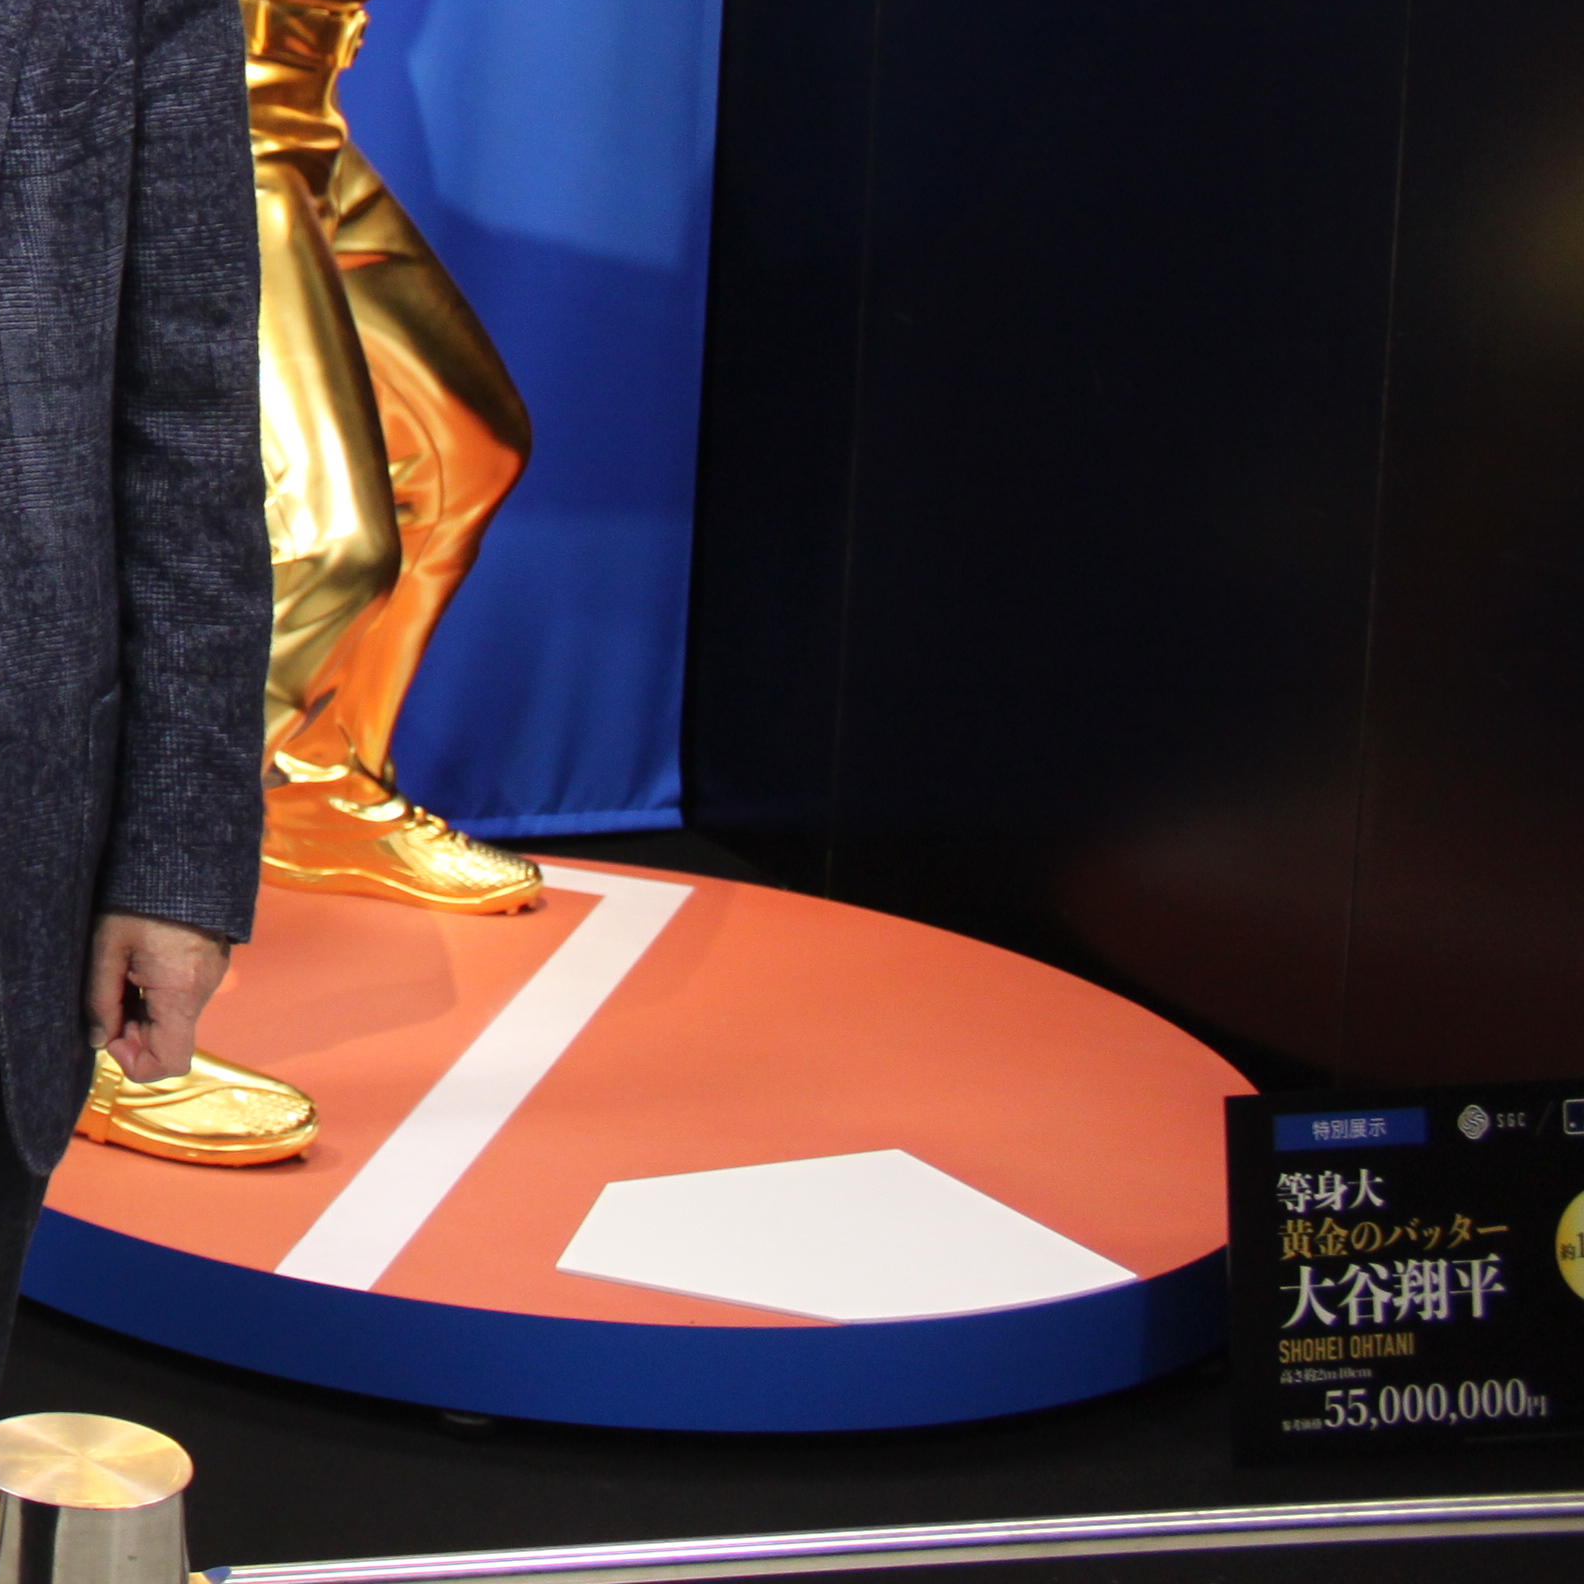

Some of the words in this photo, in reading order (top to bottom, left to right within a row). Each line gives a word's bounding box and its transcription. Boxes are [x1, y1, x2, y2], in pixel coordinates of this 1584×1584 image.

[1311, 1118, 1387, 1140] 特別展示
[1496, 1112, 1526, 1128] SGC
[1276, 1168, 1384, 1214] 等身大
[1278, 1213, 1509, 1261] 黄金のバッター
[1279, 1253, 1507, 1329] 大谷翔平
[1278, 1336, 1344, 1364] SHOHEI
[1349, 1332, 1416, 1360] OHTANI
